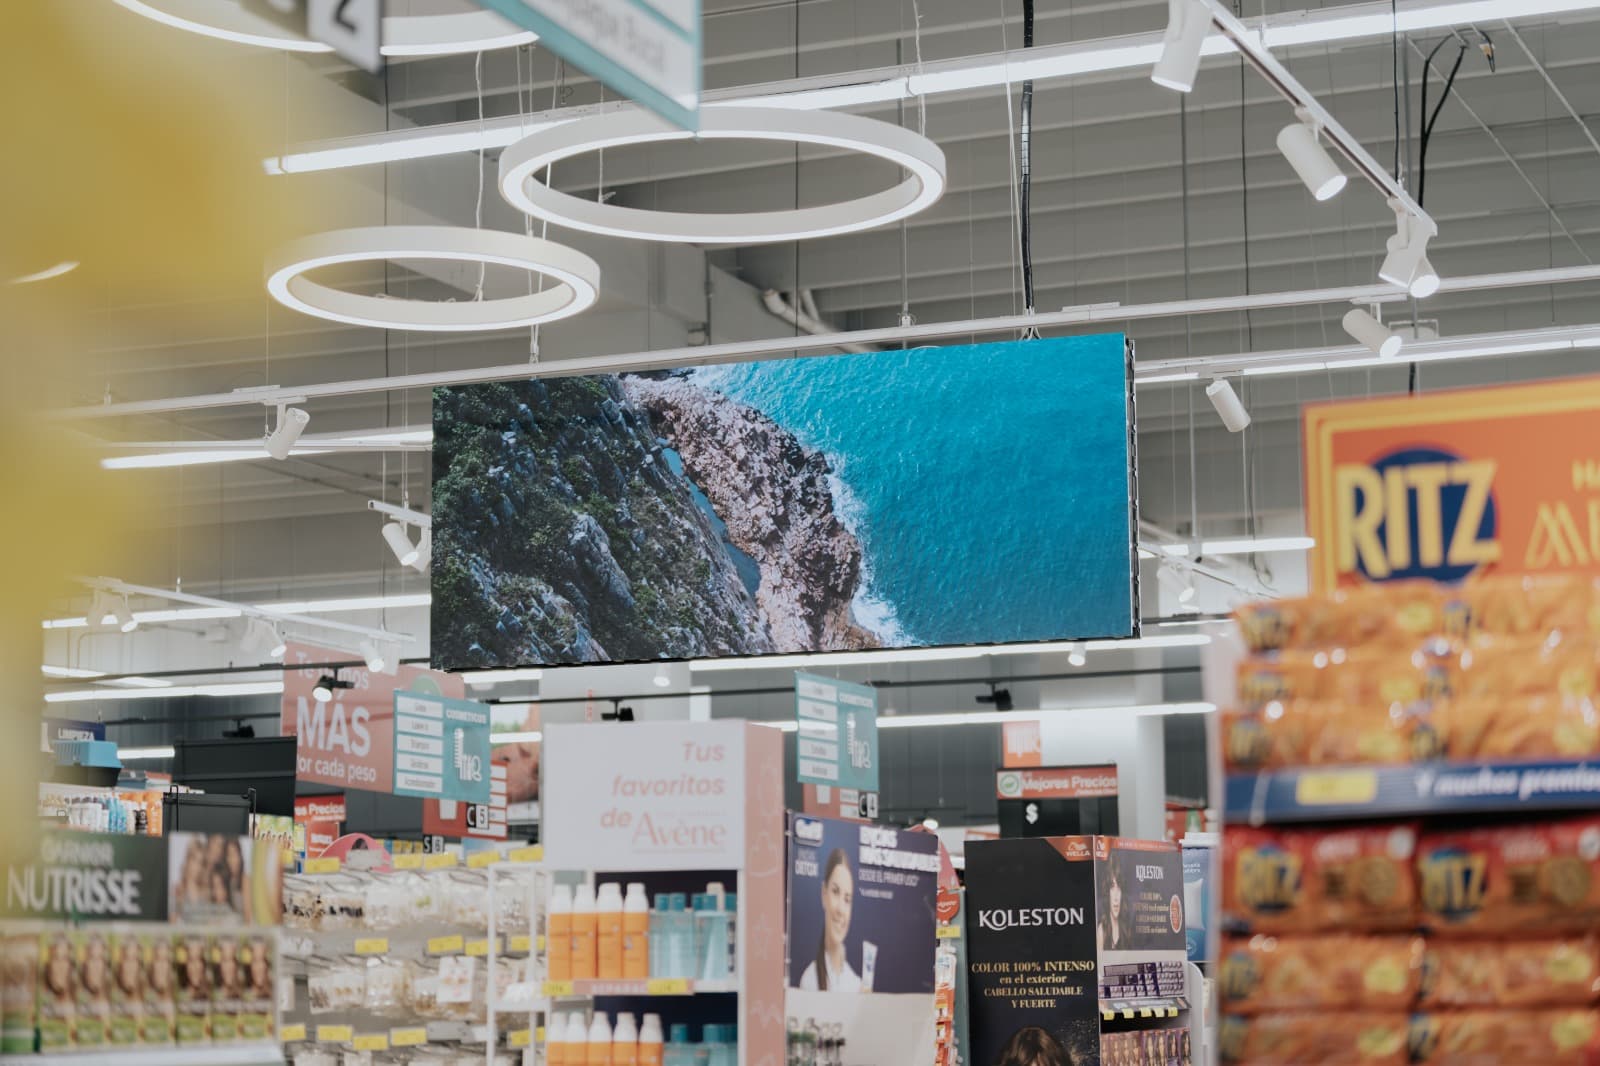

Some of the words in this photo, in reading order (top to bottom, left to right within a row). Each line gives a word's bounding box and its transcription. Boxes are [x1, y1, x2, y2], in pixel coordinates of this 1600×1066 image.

[1336, 461, 1502, 578] RITZ
[296, 686, 371, 758] MÁS
[682, 740, 726, 762] Tus
[297, 755, 312, 773] or
[315, 758, 344, 778] cada
[347, 765, 377, 785] peso
[612, 773, 726, 797] favoritos
[480, 807, 488, 824] 5
[600, 807, 632, 828] de
[1025, 802, 1039, 824] $
[1136, 864, 1164, 882] KOLESTON
[6, 864, 142, 915] NUTRISSE
[978, 907, 1085, 931] KOLESTON
[971, 962, 1010, 973] COLOR
[1013, 961, 1042, 972] 100%
[1044, 960, 1095, 972] INTENSO
[1014, 974, 1024, 984] el
[1026, 973, 1068, 984] exterior
[984, 987, 1026, 997] CABELLO
[1027, 986, 1084, 996] SALUDABLE
[1011, 999, 1018, 1009] Y
[1019, 999, 1057, 1008] FUERTE
